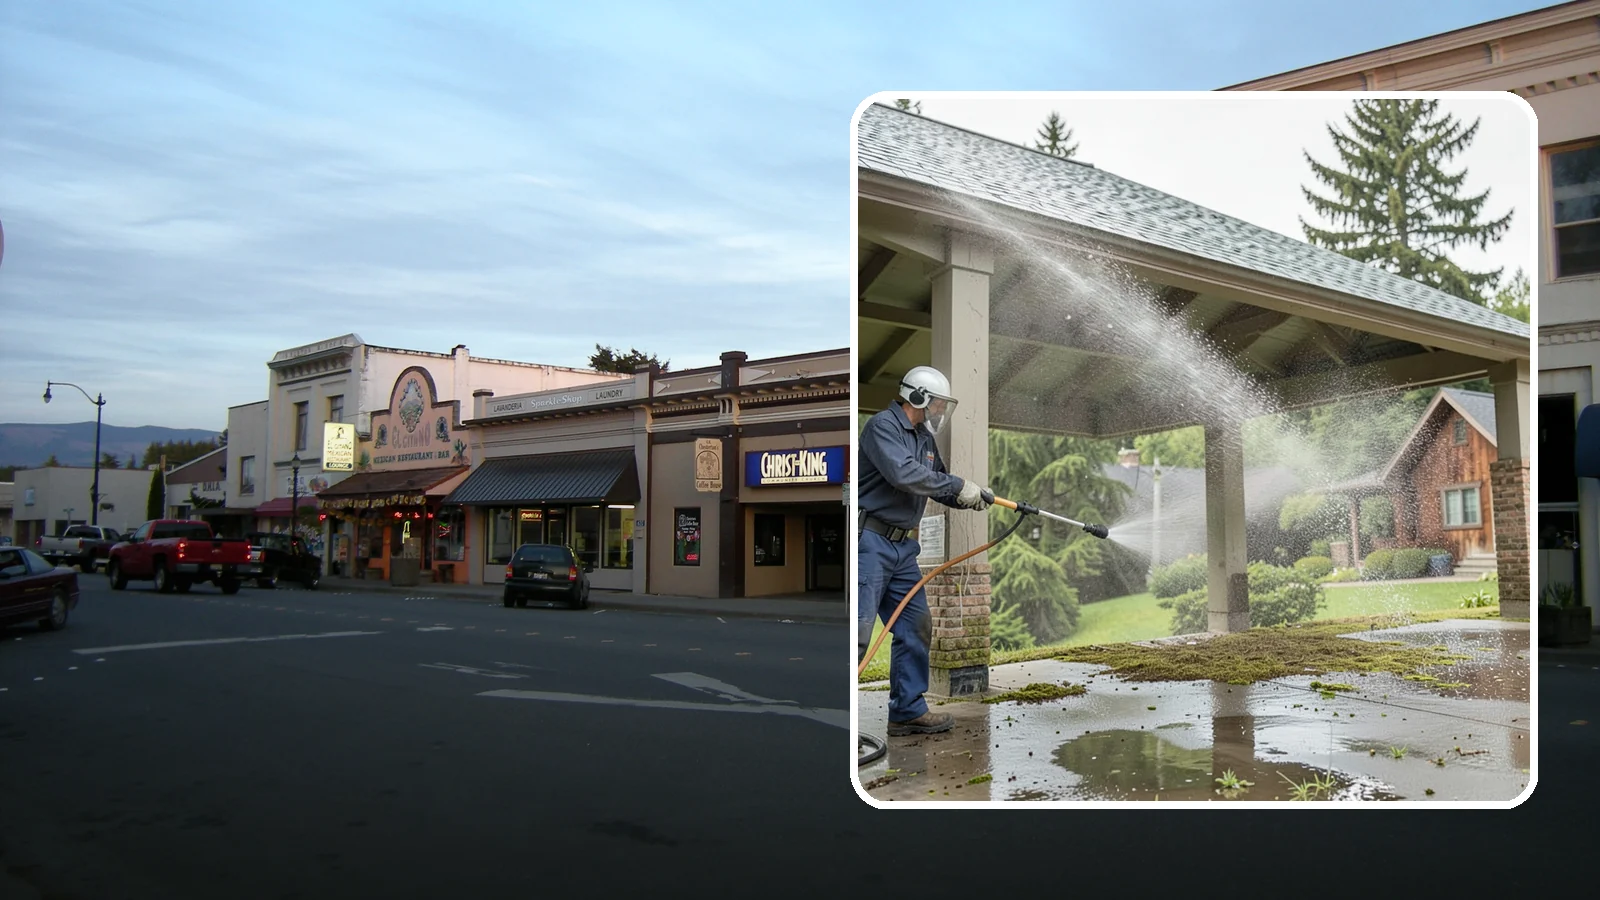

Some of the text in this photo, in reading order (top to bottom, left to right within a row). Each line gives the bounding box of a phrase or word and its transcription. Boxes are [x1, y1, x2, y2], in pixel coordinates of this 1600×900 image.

[561, 394, 582, 404] Shop
[595, 389, 623, 399] LAUNDRY
[493, 402, 522, 412] LAVANDERIA
[373, 454, 396, 464] MEXICAN
[397, 451, 433, 462] RESTAURANT
[438, 450, 450, 459] BAR
[799, 450, 827, 476] KING
